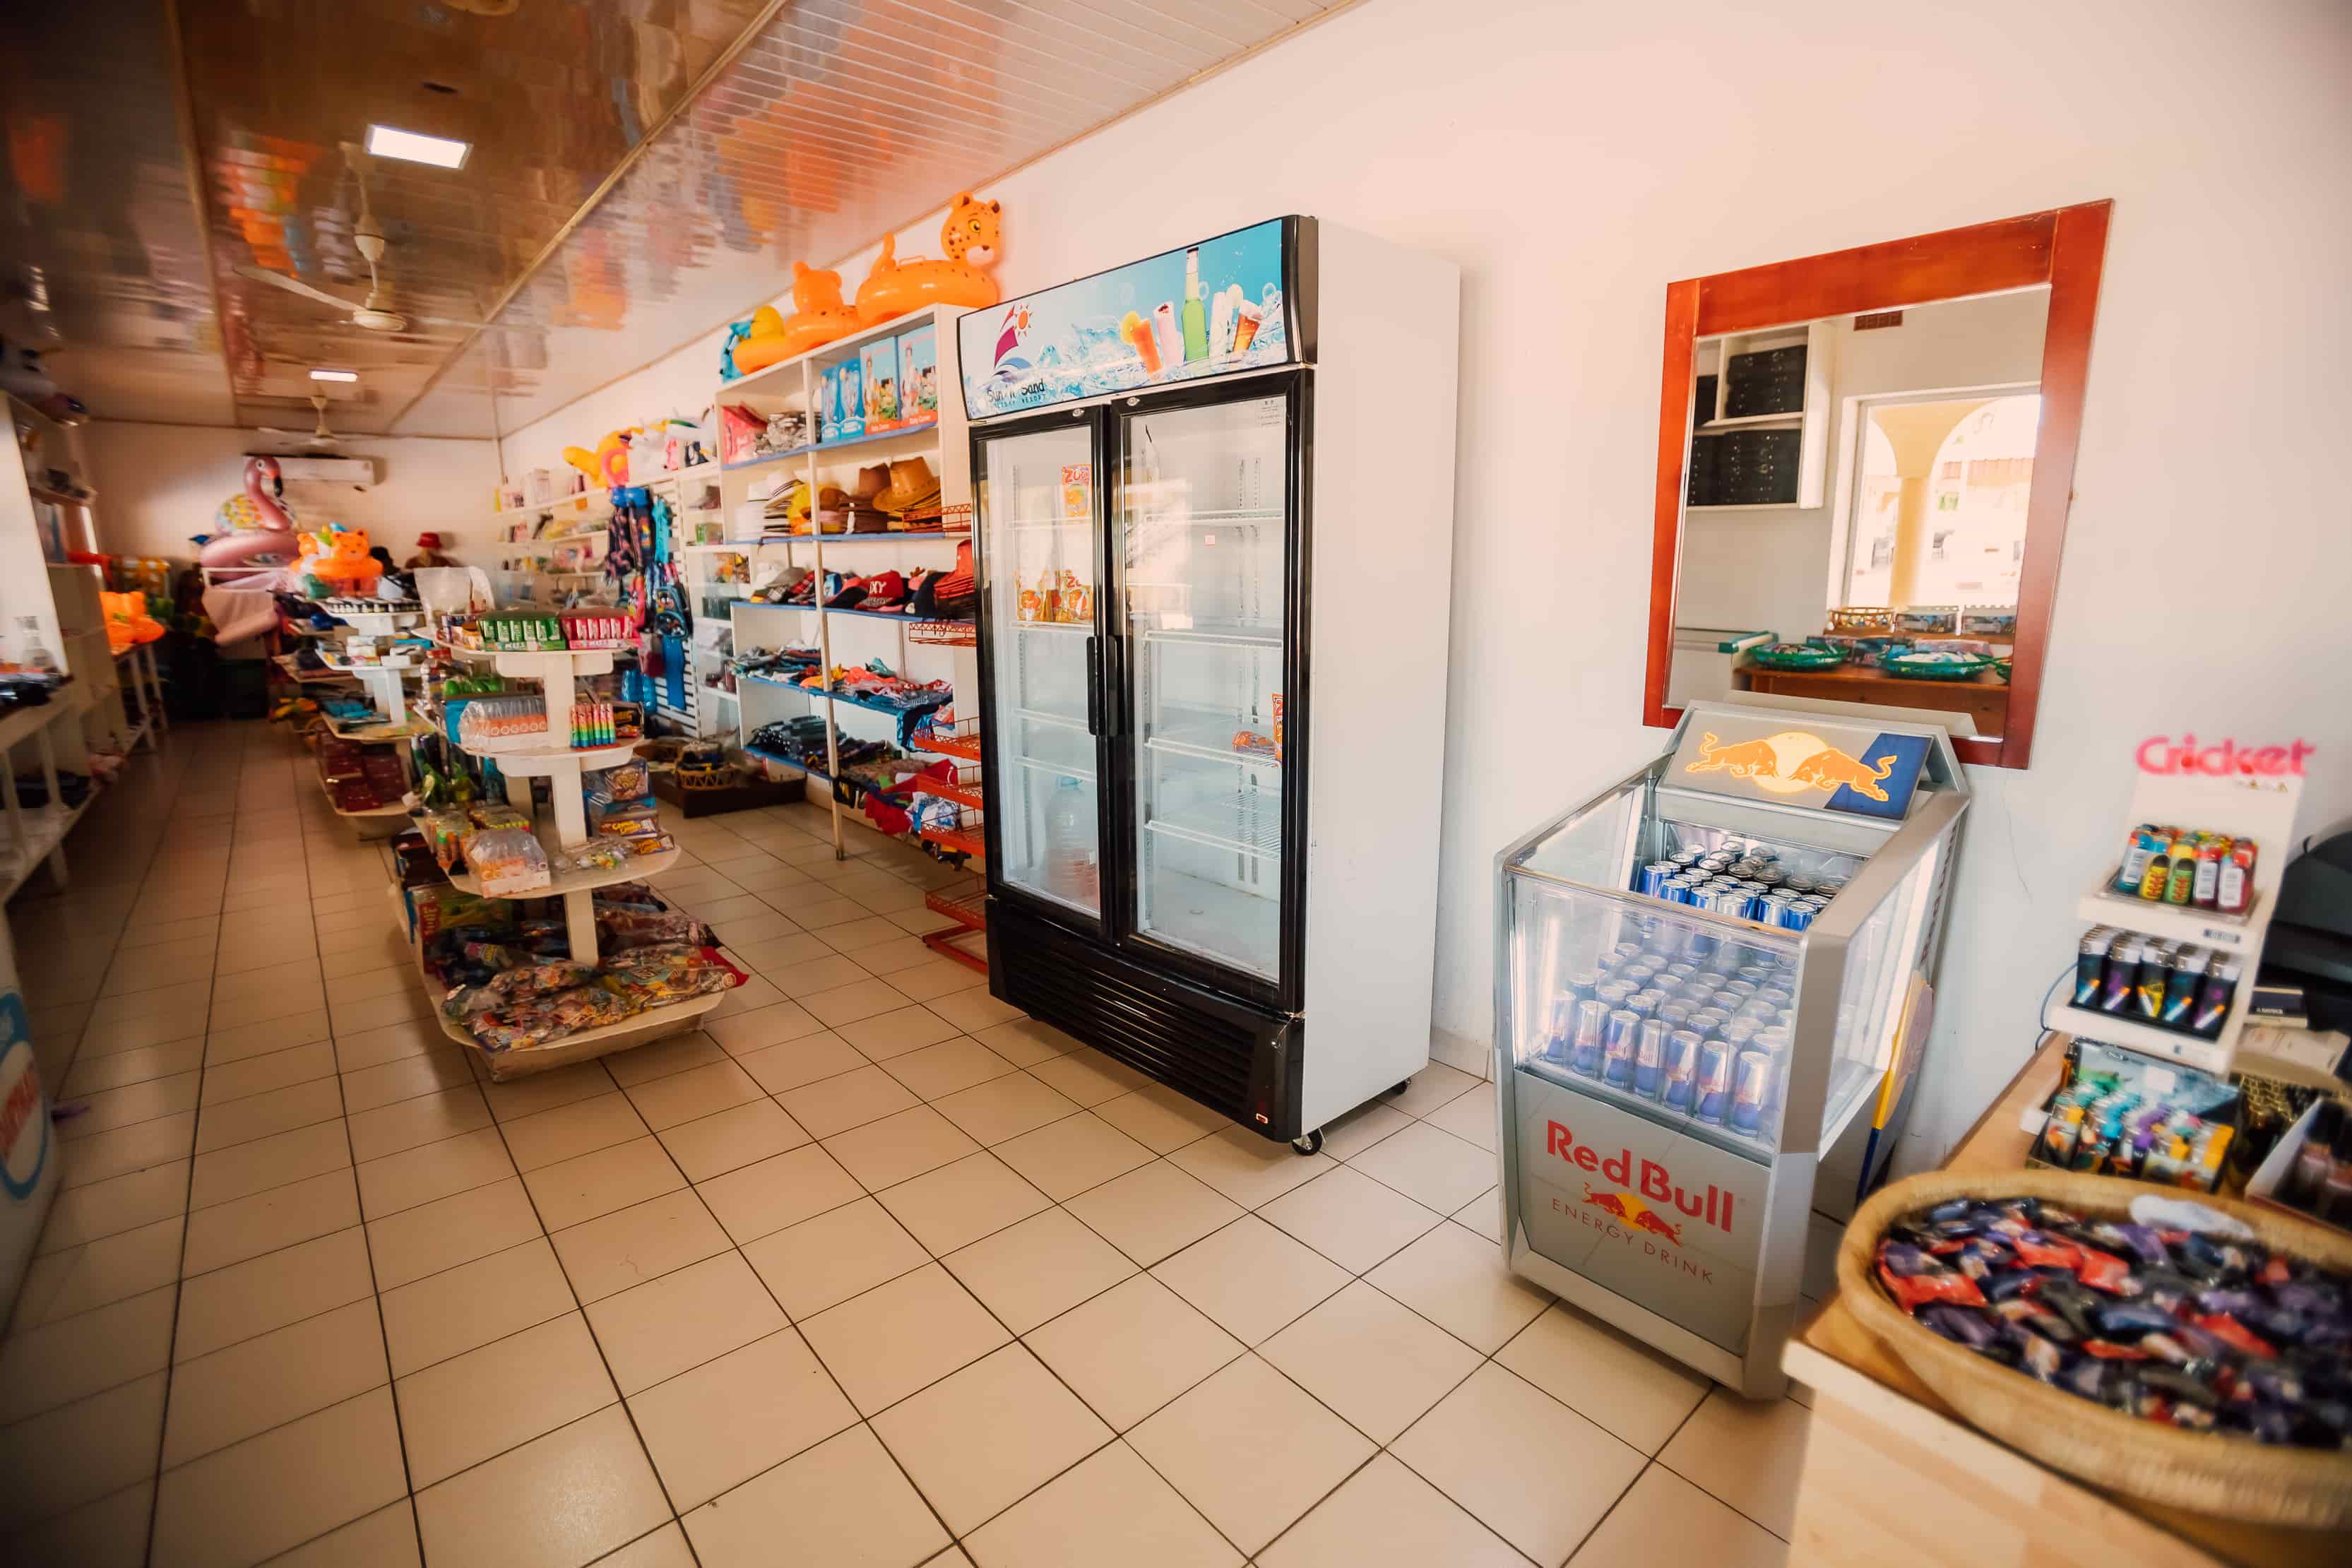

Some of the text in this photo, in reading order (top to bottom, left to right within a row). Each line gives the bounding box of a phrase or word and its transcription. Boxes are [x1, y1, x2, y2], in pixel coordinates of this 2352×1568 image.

[1021, 379, 1045, 396] Sand
[2135, 732, 2317, 777] Cricket
[1547, 1119, 1734, 1233] Red Bull
[1552, 1198, 1713, 1285] ENERGY DRINK
